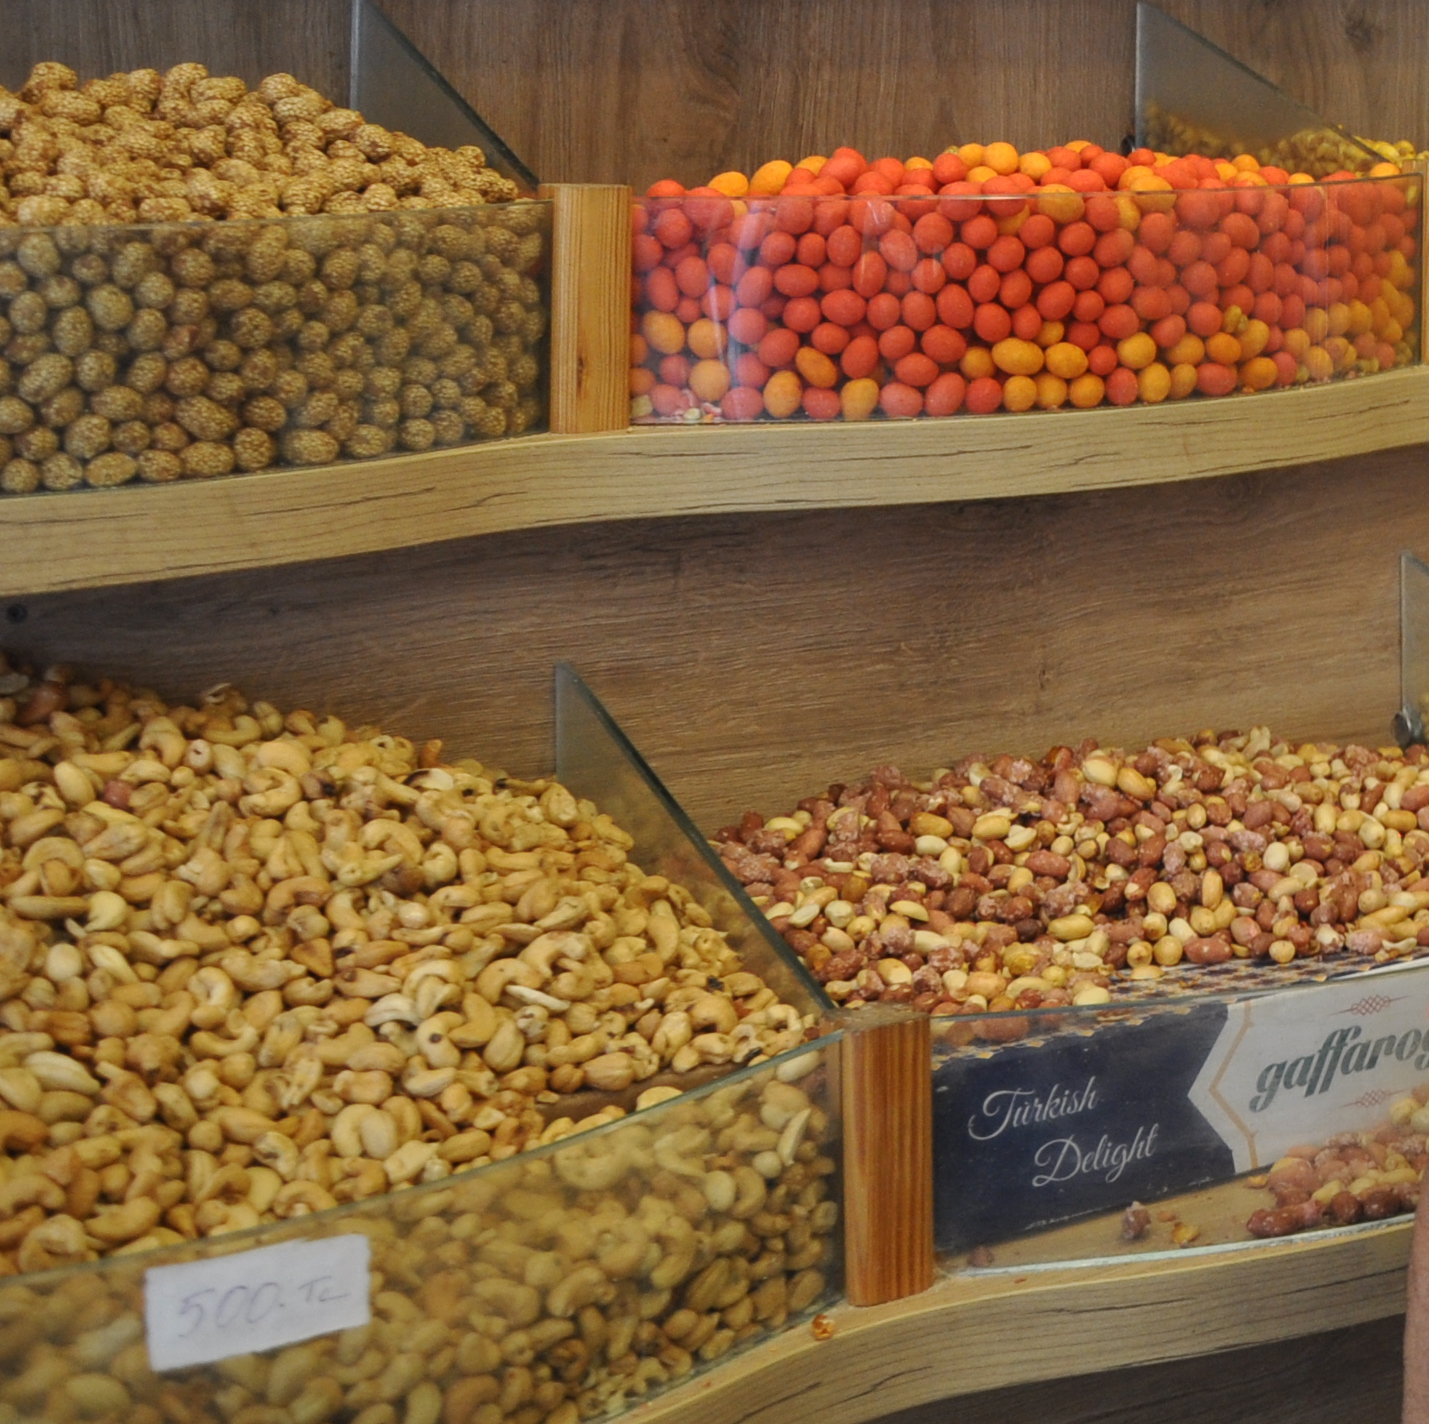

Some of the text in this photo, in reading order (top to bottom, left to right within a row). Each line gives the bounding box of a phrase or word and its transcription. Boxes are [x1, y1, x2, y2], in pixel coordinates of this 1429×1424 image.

[968, 1076, 1097, 1140] Turkish
[1032, 1123, 1159, 1187] Delight
[298, 1276, 349, 1304] TL
